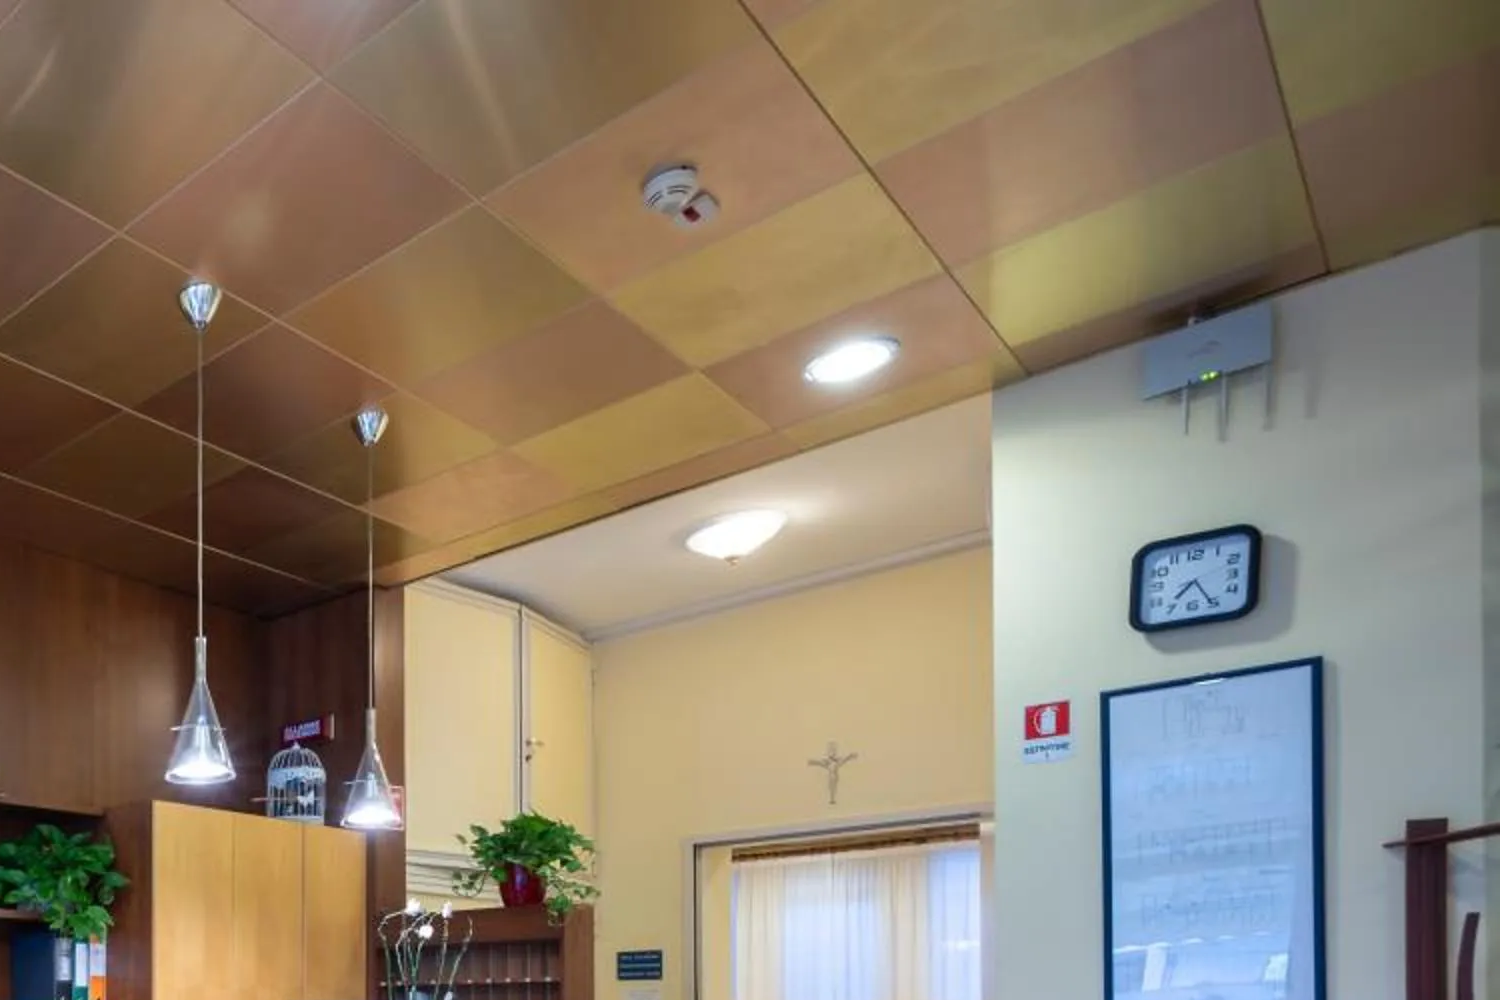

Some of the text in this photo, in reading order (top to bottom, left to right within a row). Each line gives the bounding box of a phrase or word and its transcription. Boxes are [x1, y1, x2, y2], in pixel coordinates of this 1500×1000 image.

[1187, 549, 1205, 561] 12
[1227, 553, 1241, 565] 2
[1225, 583, 1239, 594] 4
[1167, 603, 1178, 614] 7
[1186, 600, 1199, 611] 6
